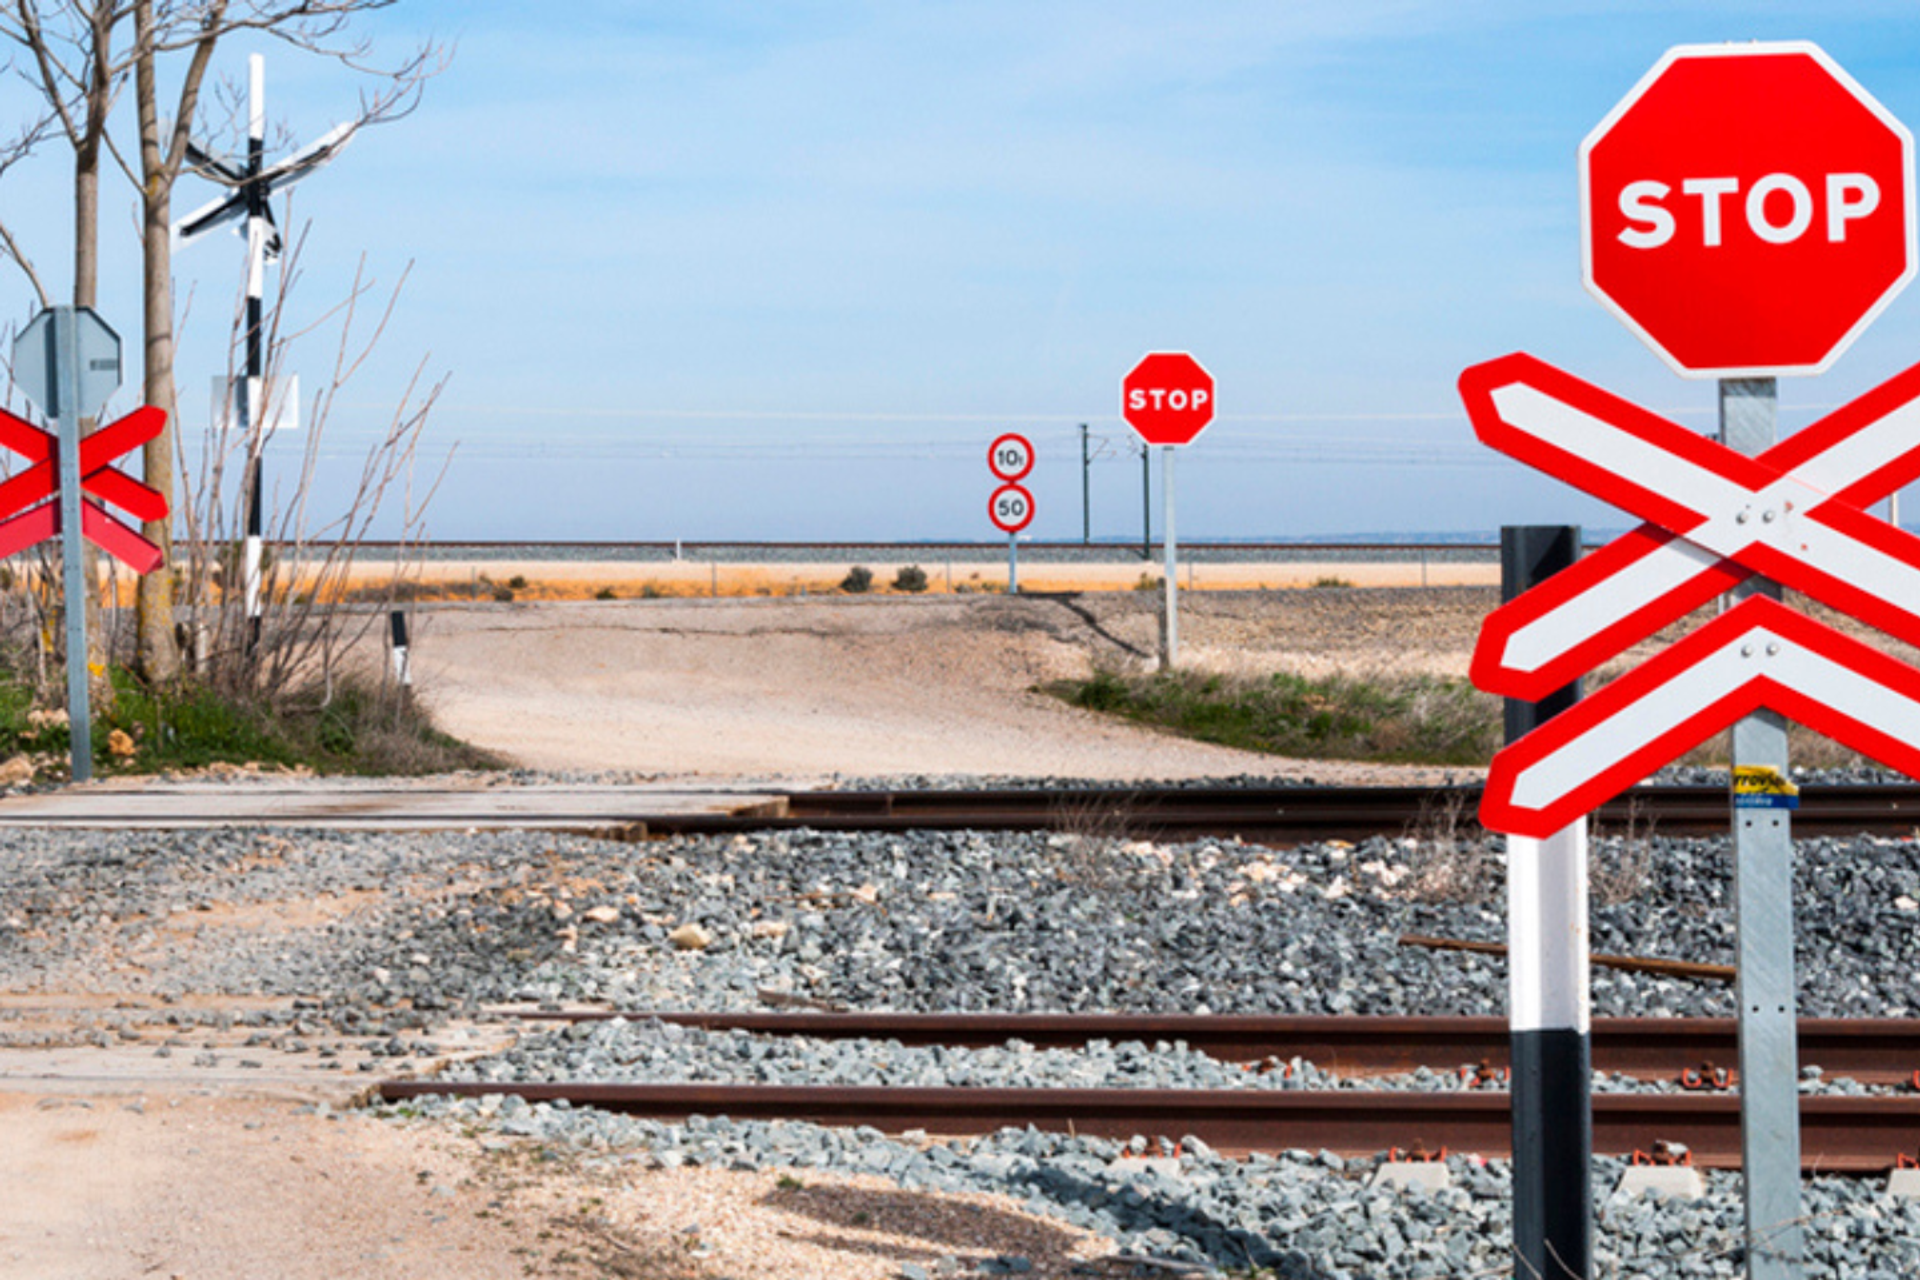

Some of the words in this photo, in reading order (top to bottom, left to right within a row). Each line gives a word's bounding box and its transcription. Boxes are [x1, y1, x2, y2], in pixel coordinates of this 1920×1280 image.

[1617, 172, 1881, 249] STOP
[1129, 389, 1208, 410] STOP
[998, 499, 1025, 516] 50
